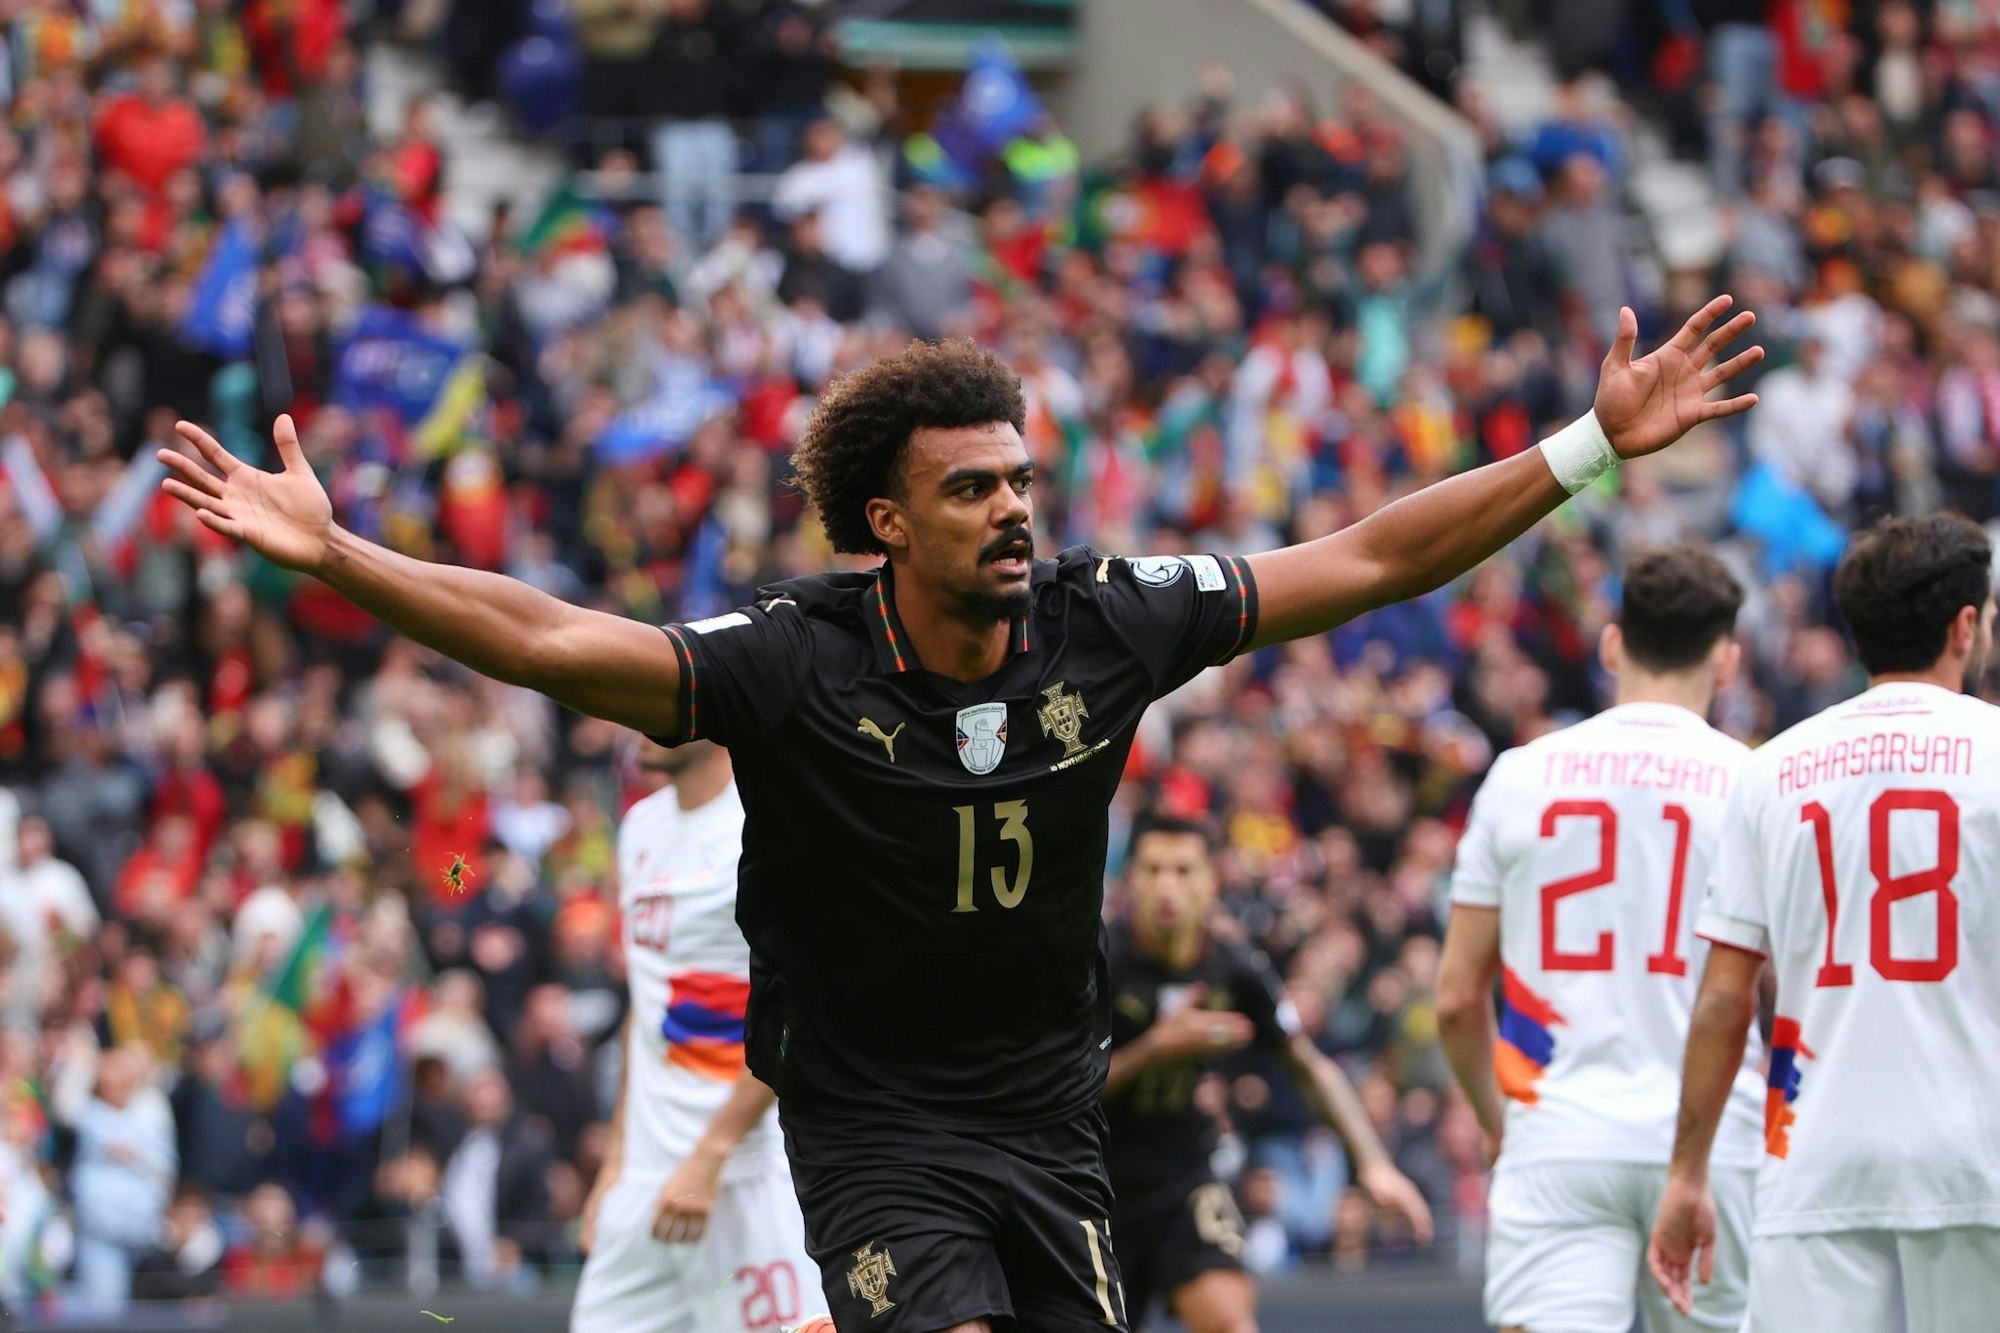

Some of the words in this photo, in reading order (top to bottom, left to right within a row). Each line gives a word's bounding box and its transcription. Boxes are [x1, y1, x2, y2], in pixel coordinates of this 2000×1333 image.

[1543, 751, 1728, 798] TIKNIZYAN
[1778, 733, 1972, 796] AGHASARYAN
[951, 799, 1033, 912] 13
[1540, 799, 1692, 977] 21
[1801, 789, 1959, 987] 18
[632, 895, 677, 952] 20
[736, 1260, 799, 1329] 20
